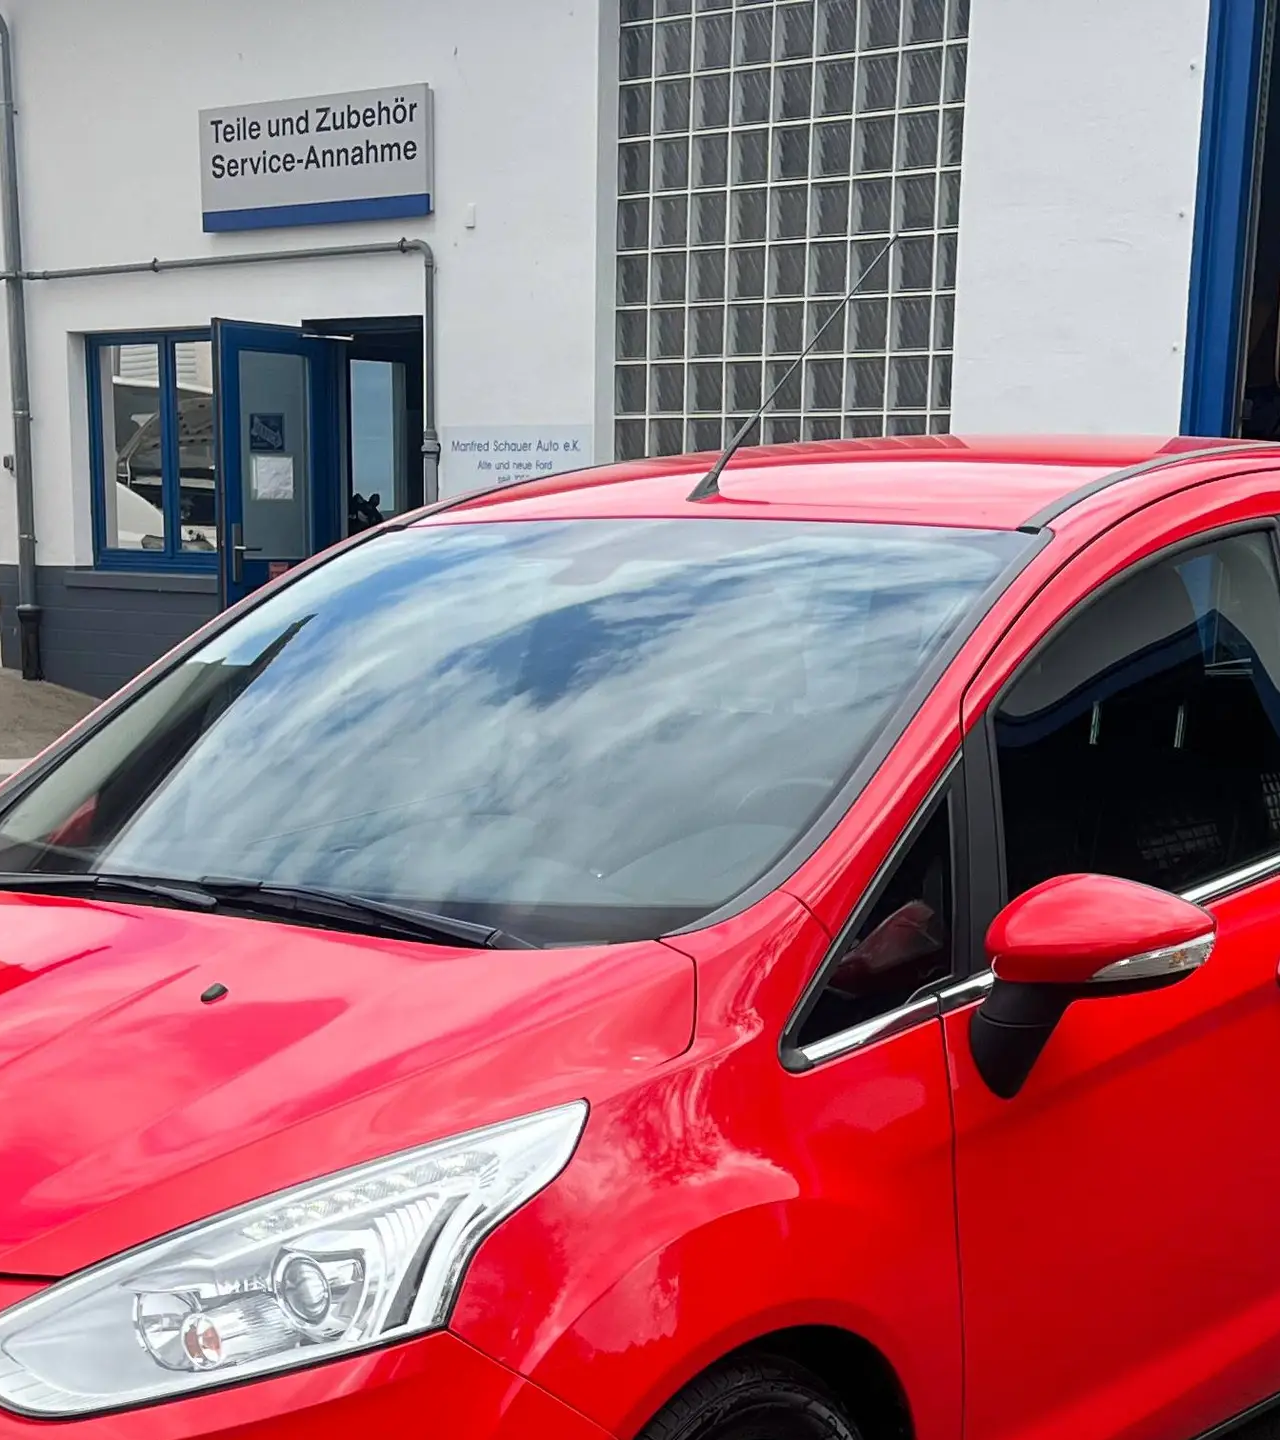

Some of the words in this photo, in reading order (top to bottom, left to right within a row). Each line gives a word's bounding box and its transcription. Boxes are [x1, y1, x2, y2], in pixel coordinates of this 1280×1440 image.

[210, 117, 261, 143] Teile
[268, 110, 309, 137] und
[316, 97, 417, 133] Zubehör
[212, 140, 417, 179] Service-Annahme
[451, 440, 489, 452] Manfred
[493, 440, 531, 452] Schauer
[536, 440, 559, 452] Auto
[477, 460, 492, 470] Alte
[495, 460, 510, 470] und
[513, 460, 532, 470] neue
[535, 460, 553, 470] Ford
